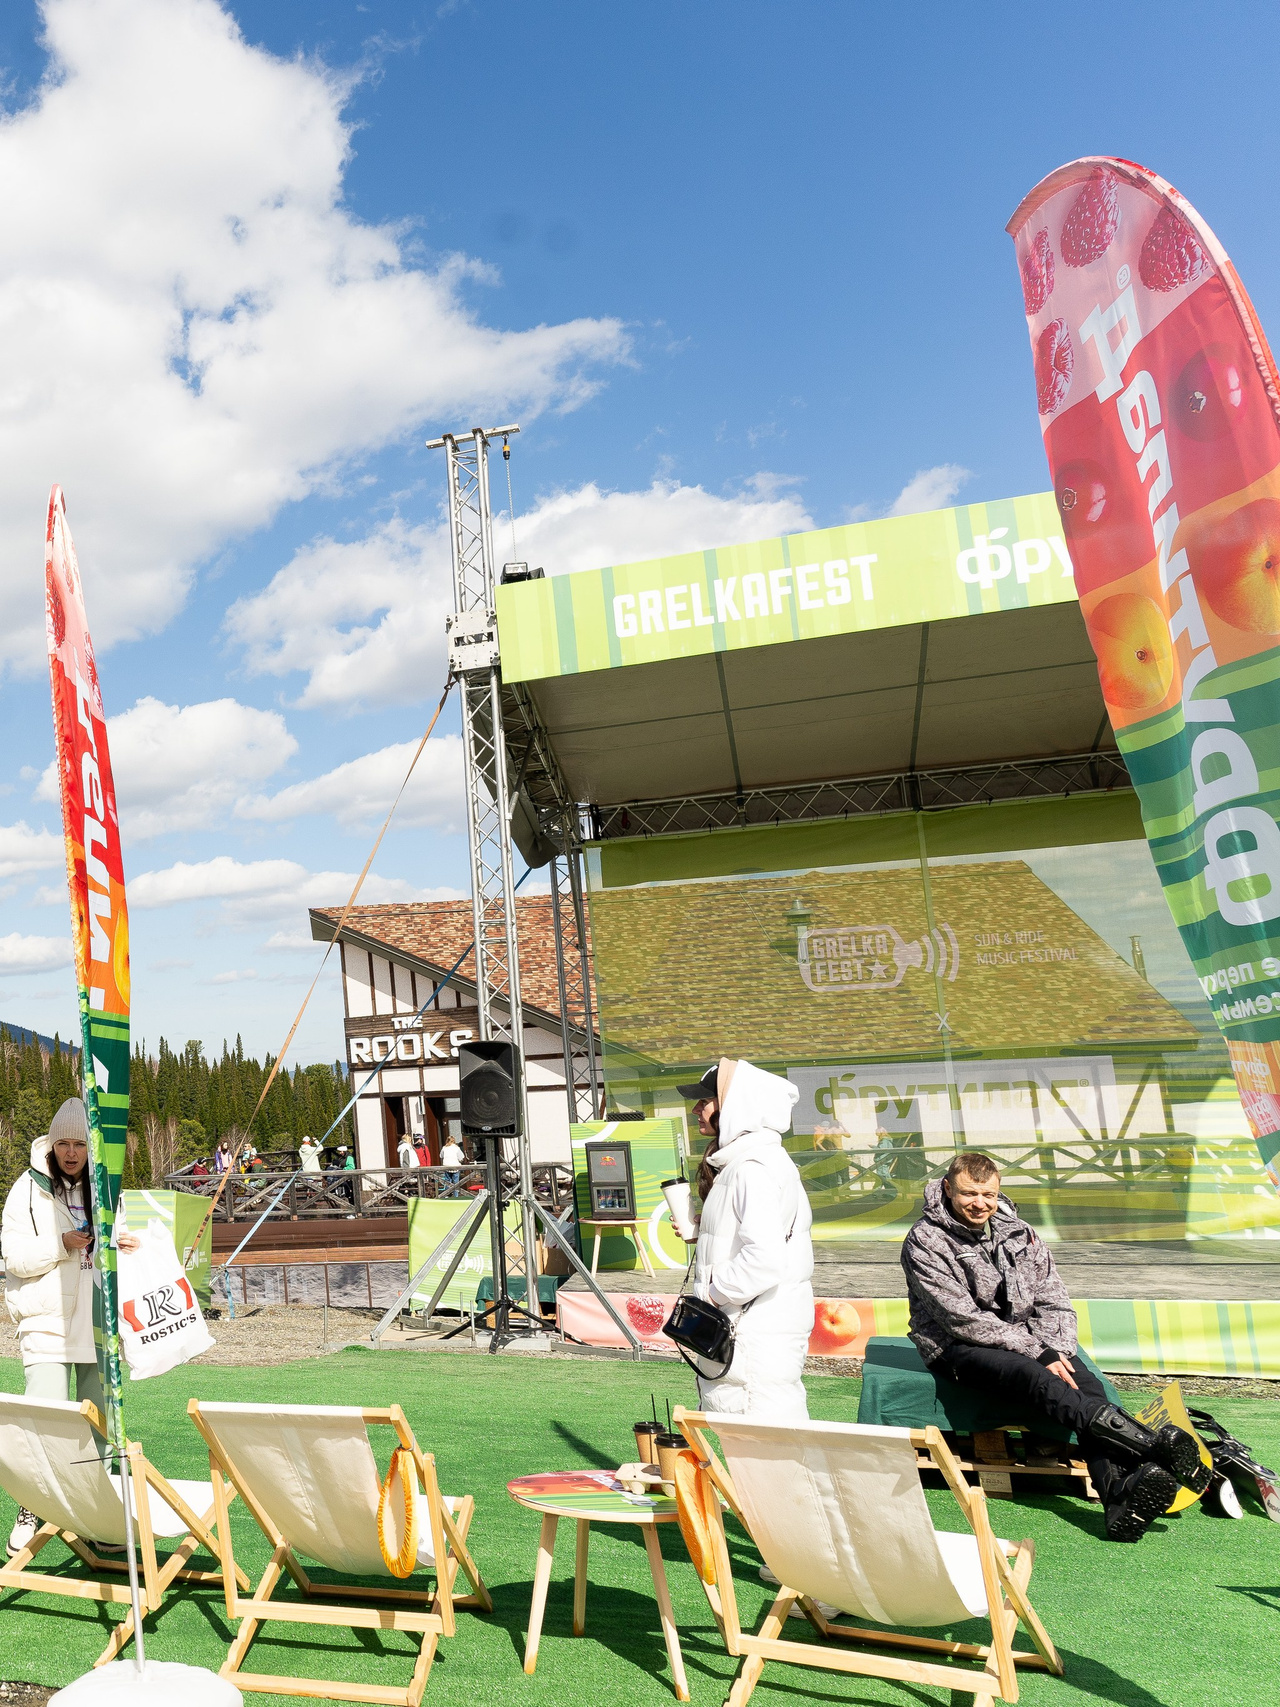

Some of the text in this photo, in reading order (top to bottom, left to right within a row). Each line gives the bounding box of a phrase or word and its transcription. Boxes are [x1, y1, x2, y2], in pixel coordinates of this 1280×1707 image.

[613, 553, 878, 638] GRELKAFEST
[813, 934, 888, 958] GRELKA
[974, 930, 1045, 946] SUN & RIDE
[815, 959, 865, 982] FEST
[976, 948, 1079, 965] MUSIC FESTIVAL
[391, 1016, 423, 1030] THE
[349, 1030, 473, 1063] ROOKS
[814, 1073, 1083, 1120] фрутилад
[143, 1285, 182, 1327] R
[140, 1313, 197, 1345] ROSTIC'S
